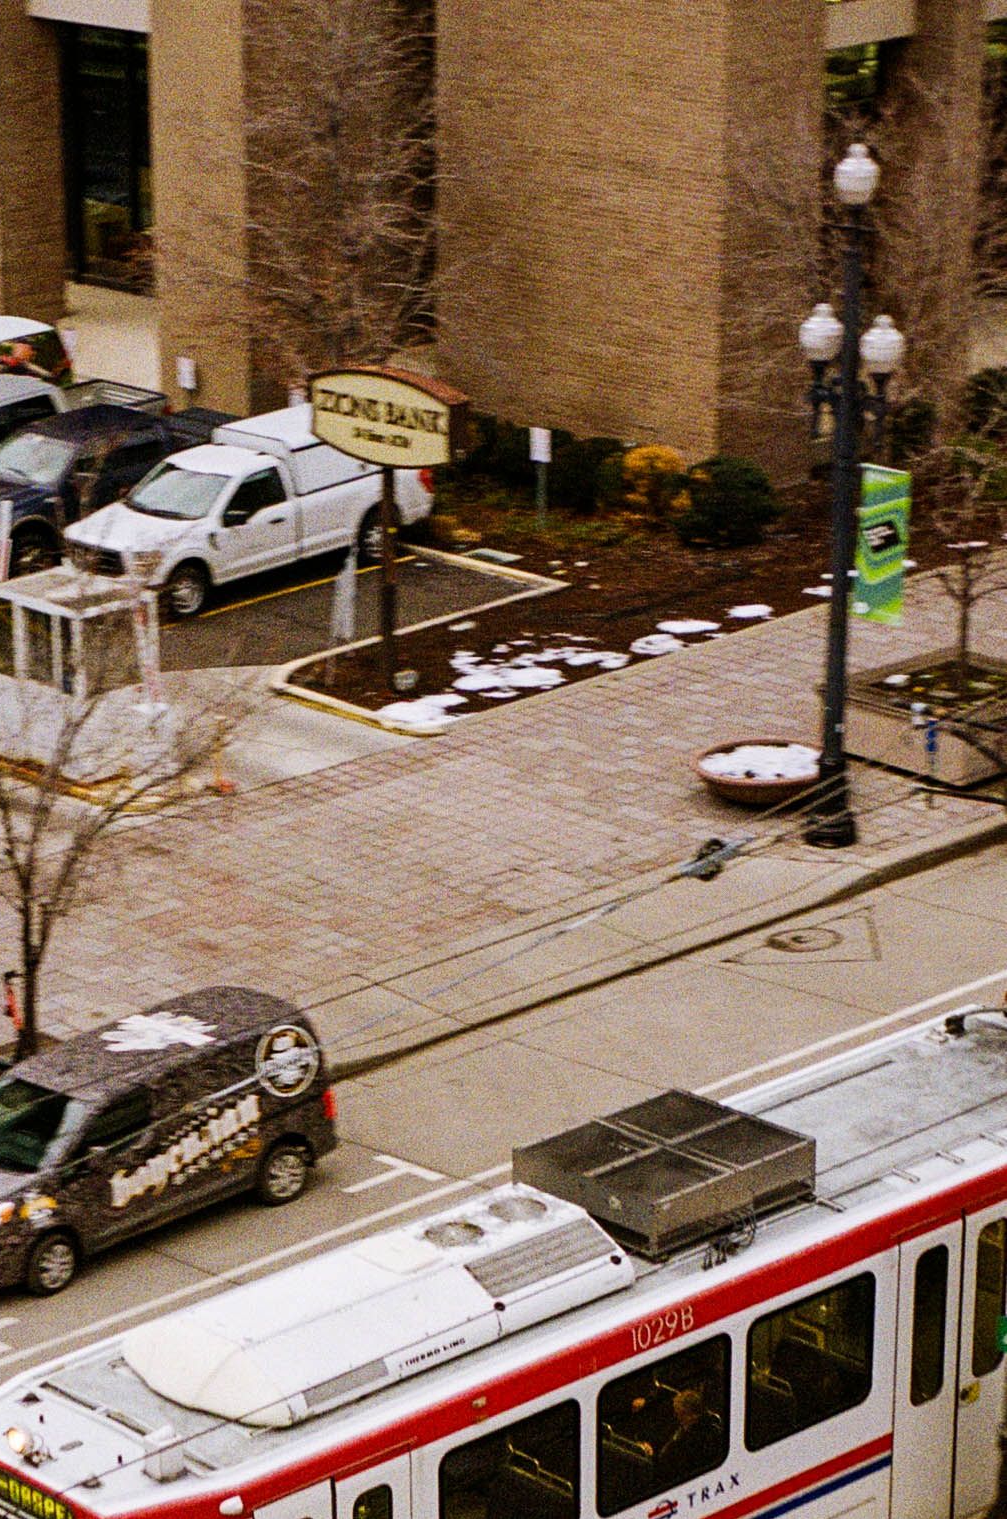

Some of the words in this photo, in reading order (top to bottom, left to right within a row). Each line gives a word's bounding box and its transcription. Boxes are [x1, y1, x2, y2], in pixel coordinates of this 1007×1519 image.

[384, 401, 450, 435] BANK
[631, 1305, 694, 1352] 1029B
[686, 1472, 741, 1508] TRAX
